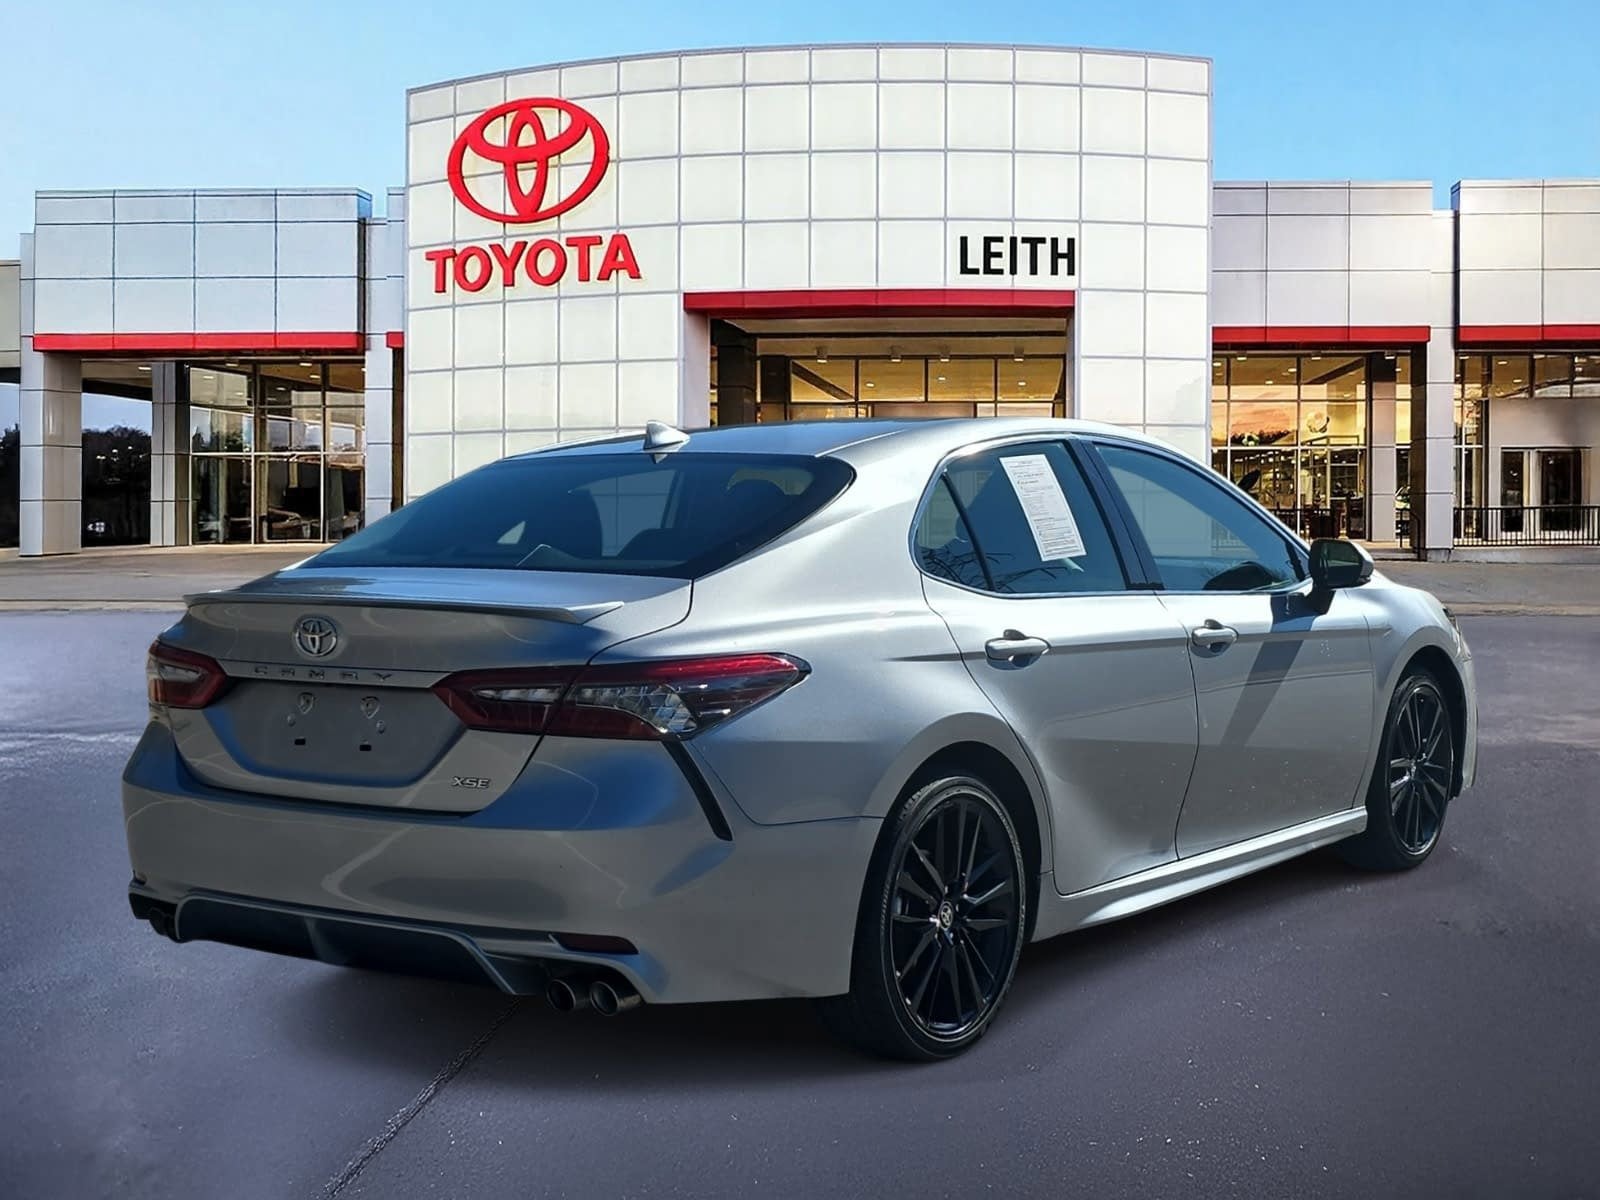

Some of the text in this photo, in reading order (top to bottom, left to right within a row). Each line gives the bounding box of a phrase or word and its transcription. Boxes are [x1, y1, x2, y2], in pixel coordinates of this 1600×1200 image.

[425, 233, 641, 293] TOYOTA
[959, 235, 1075, 276] LEITH
[253, 665, 393, 683] CAMRY
[451, 776, 490, 789] XSE
